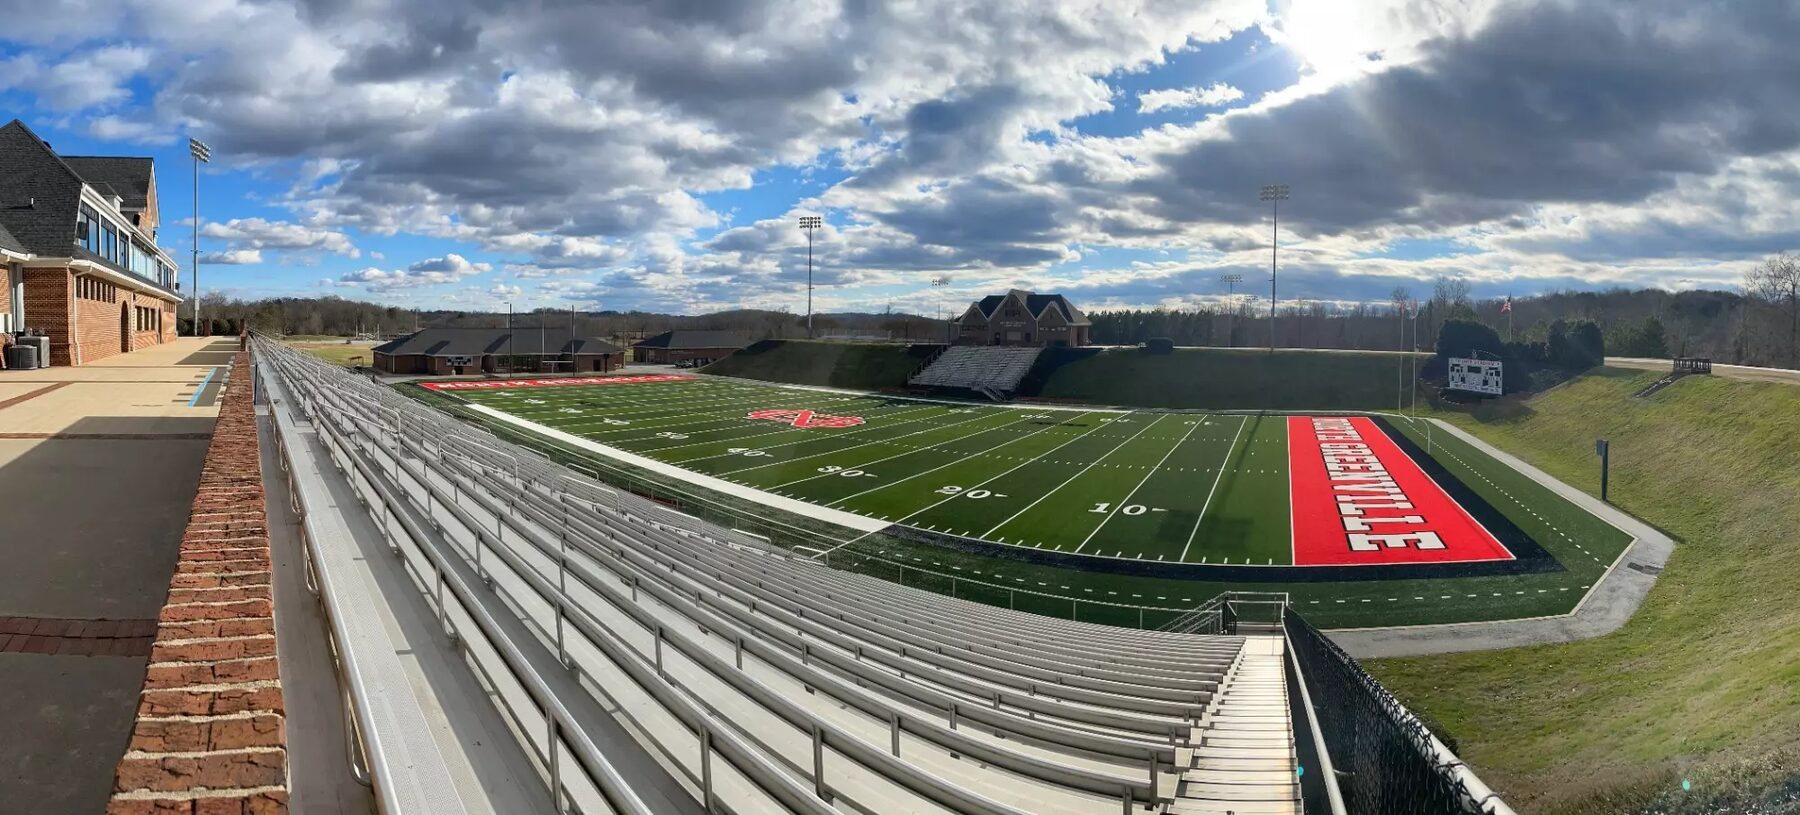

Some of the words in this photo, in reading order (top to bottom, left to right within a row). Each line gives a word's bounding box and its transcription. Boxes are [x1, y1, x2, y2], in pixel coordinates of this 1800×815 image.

[817, 465, 865, 478] 30
[934, 485, 992, 499] 20
[1319, 442, 1448, 551] GREENVILLE
[1088, 503, 1147, 516] 10
